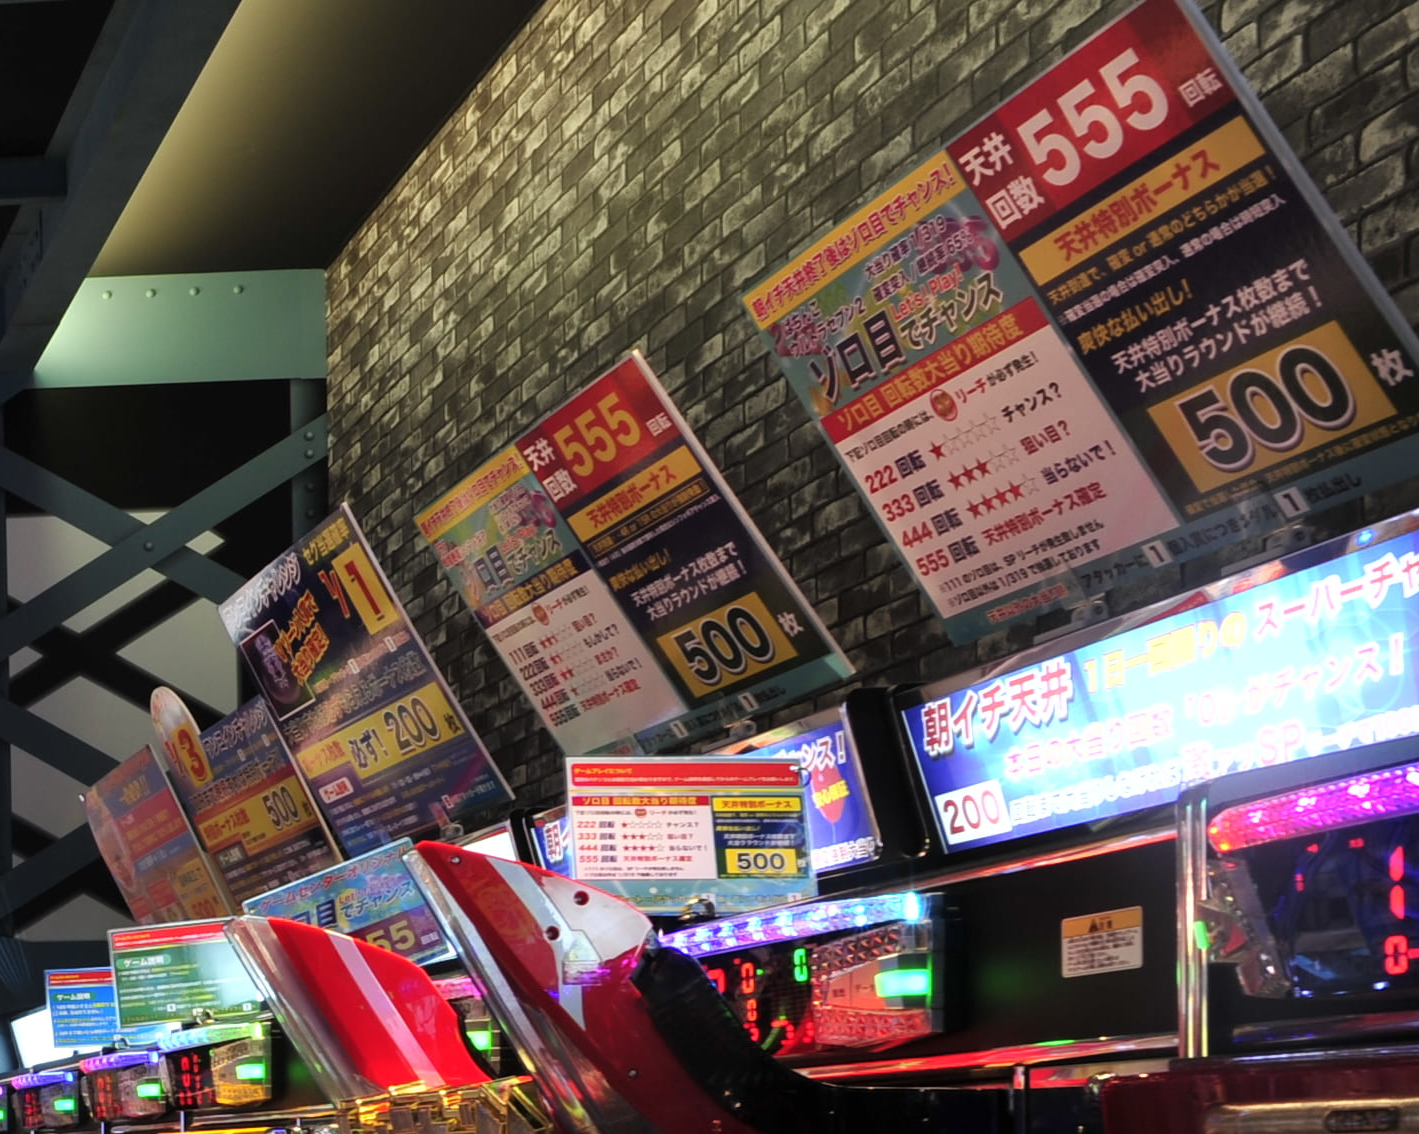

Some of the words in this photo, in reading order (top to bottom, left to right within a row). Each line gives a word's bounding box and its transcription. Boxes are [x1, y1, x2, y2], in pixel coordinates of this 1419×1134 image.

[958, 132, 1014, 187] 天井
[1016, 47, 1170, 189] 555
[1178, 67, 1223, 108] 回転
[986, 178, 1045, 231] 回数
[1053, 149, 1221, 261] 天井特別ボーナス
[838, 394, 884, 432] ゾロ目
[1174, 344, 1357, 473] 500
[1371, 348, 1414, 387] 枚
[523, 437, 557, 472] 天井
[552, 391, 642, 477] 555
[865, 465, 899, 493] 222
[882, 494, 916, 522] 333
[901, 521, 934, 548] 444
[916, 549, 950, 576] 555
[671, 605, 776, 686] 500
[383, 697, 441, 755] 200
[923, 657, 1074, 758] 朝イチ天井
[262, 785, 302, 831] 500
[942, 789, 1001, 836] 200
[736, 852, 786, 871] 500
